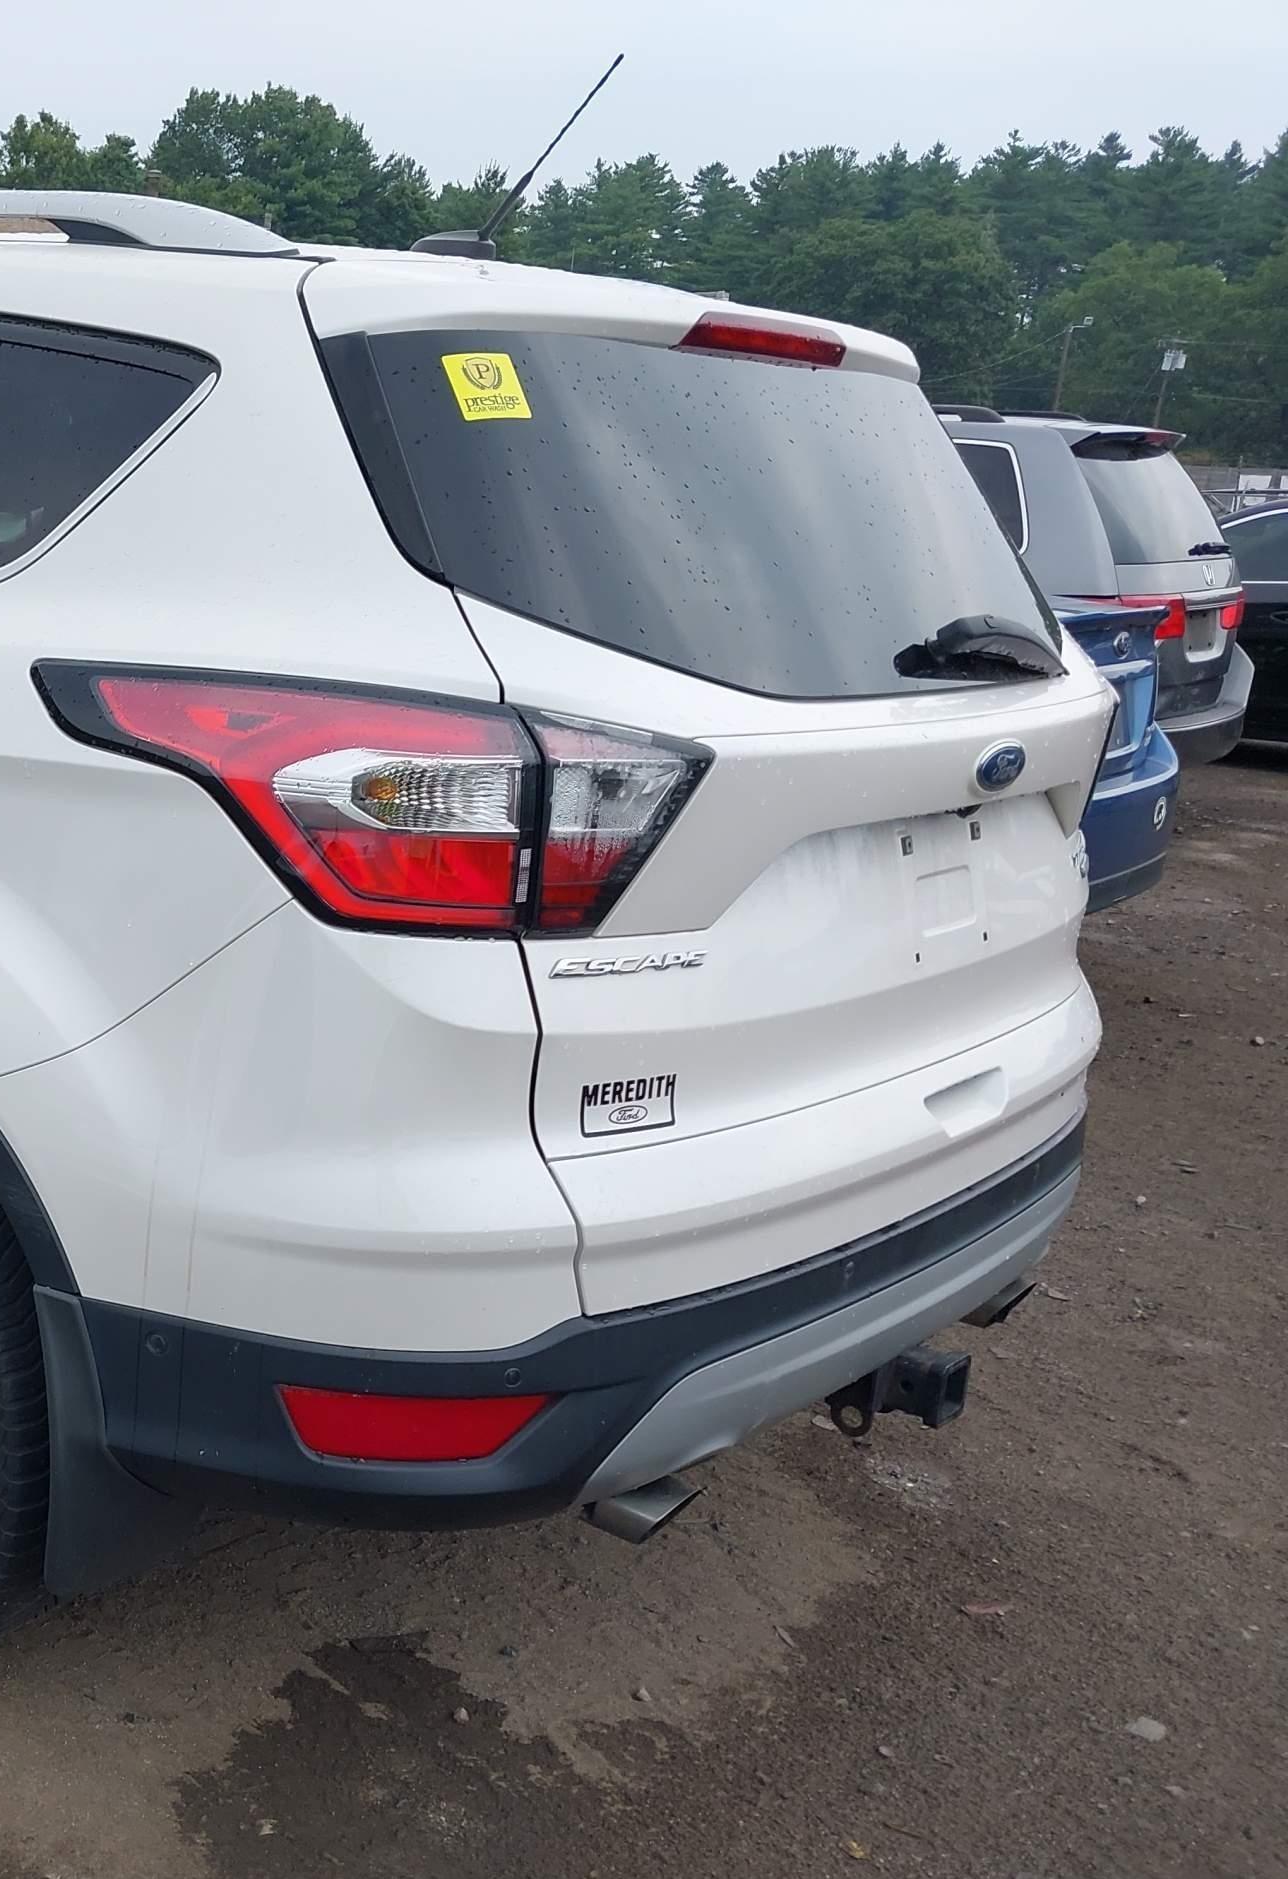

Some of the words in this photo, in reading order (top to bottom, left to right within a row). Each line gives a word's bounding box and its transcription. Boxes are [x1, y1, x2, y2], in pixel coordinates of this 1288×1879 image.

[472, 363, 489, 380] P
[463, 393, 521, 412] prestige
[549, 950, 708, 978] ESCAPE
[582, 1073, 676, 1107] MEREDITH
[616, 1108, 641, 1121] Ford
